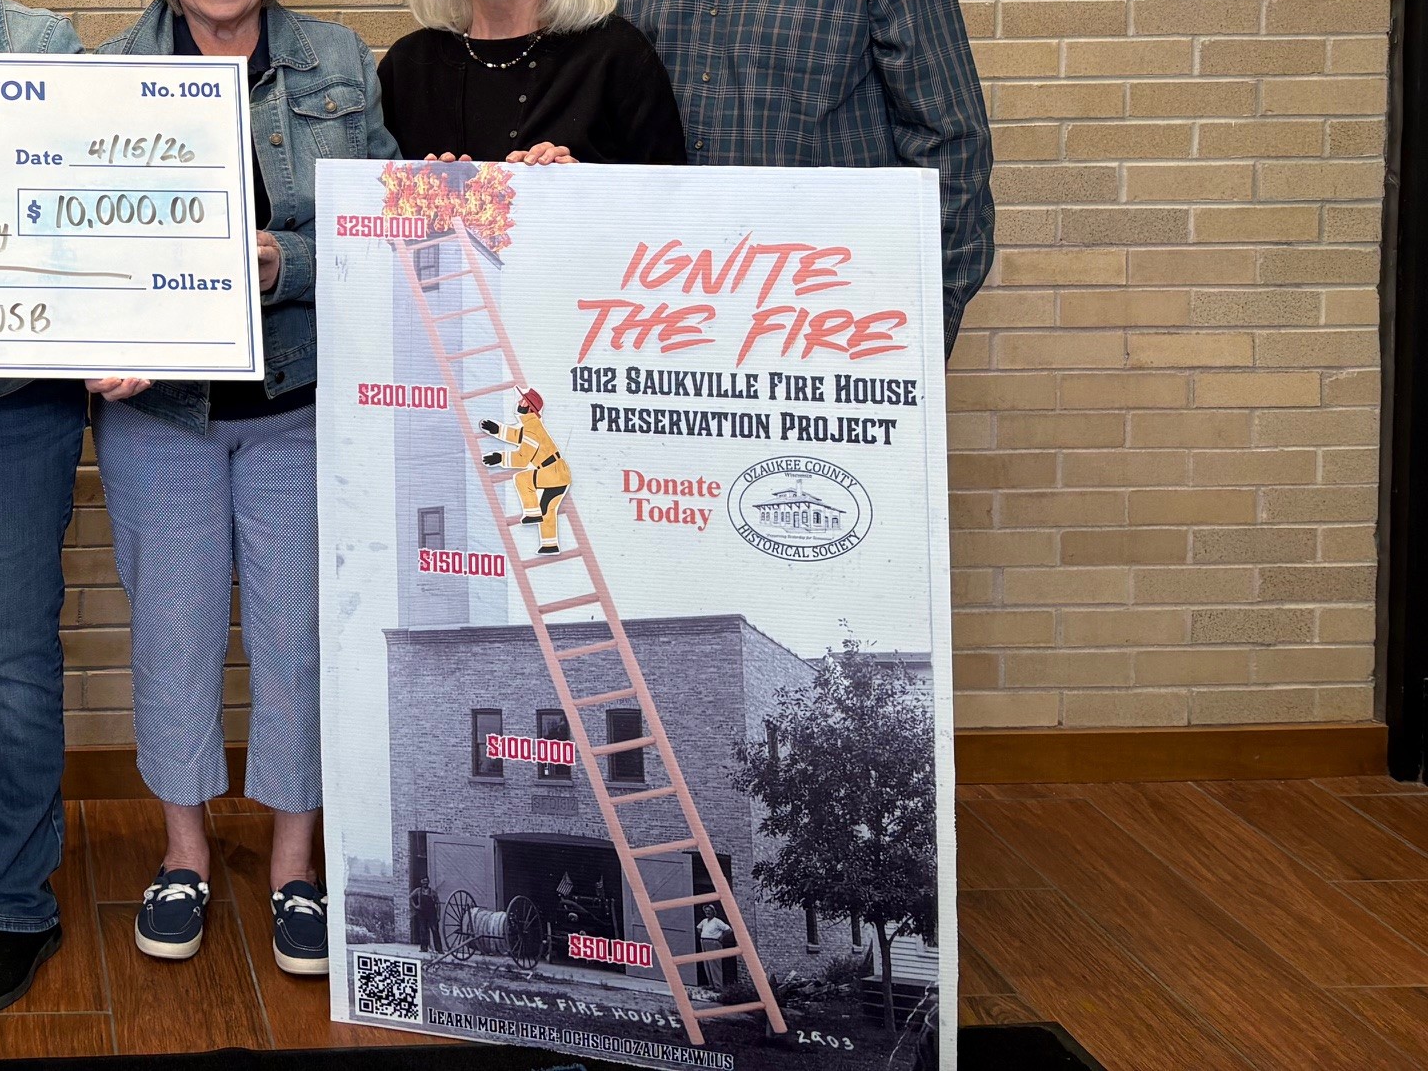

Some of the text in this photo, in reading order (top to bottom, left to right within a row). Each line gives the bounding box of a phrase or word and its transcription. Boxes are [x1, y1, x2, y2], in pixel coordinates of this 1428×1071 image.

[141, 82, 222, 98] No. 1001
[15, 149, 63, 165] Date
[88, 133, 196, 166] 4/15/26
[27, 200, 42, 223] $
[56, 194, 205, 228] 10,000.00
[336, 215, 426, 239] $250,000
[152, 274, 232, 290] Dollars
[620, 230, 852, 309] IGNITE
[576, 299, 909, 368] THE FIRE
[358, 383, 448, 409] $200,000
[570, 366, 918, 406] 1912 SAUKVILLE FIRE HOUSE
[590, 403, 898, 445] PRESERVATION PROJECT
[621, 469, 721, 498] Donate
[743, 459, 858, 490] OZAUKEE COUNTY
[629, 497, 713, 531] Today
[737, 523, 861, 558] HISTORICAL SOCIETY
[418, 549, 506, 577] $150,000
[487, 734, 575, 764] $100,000
[568, 934, 653, 967] $50,000
[438, 982, 682, 1028] SAUKVILLE FIRE HOUSE
[428, 1008, 473, 1029] LEARN
[477, 1016, 515, 1036] MORE
[519, 1023, 560, 1042] HERE:
